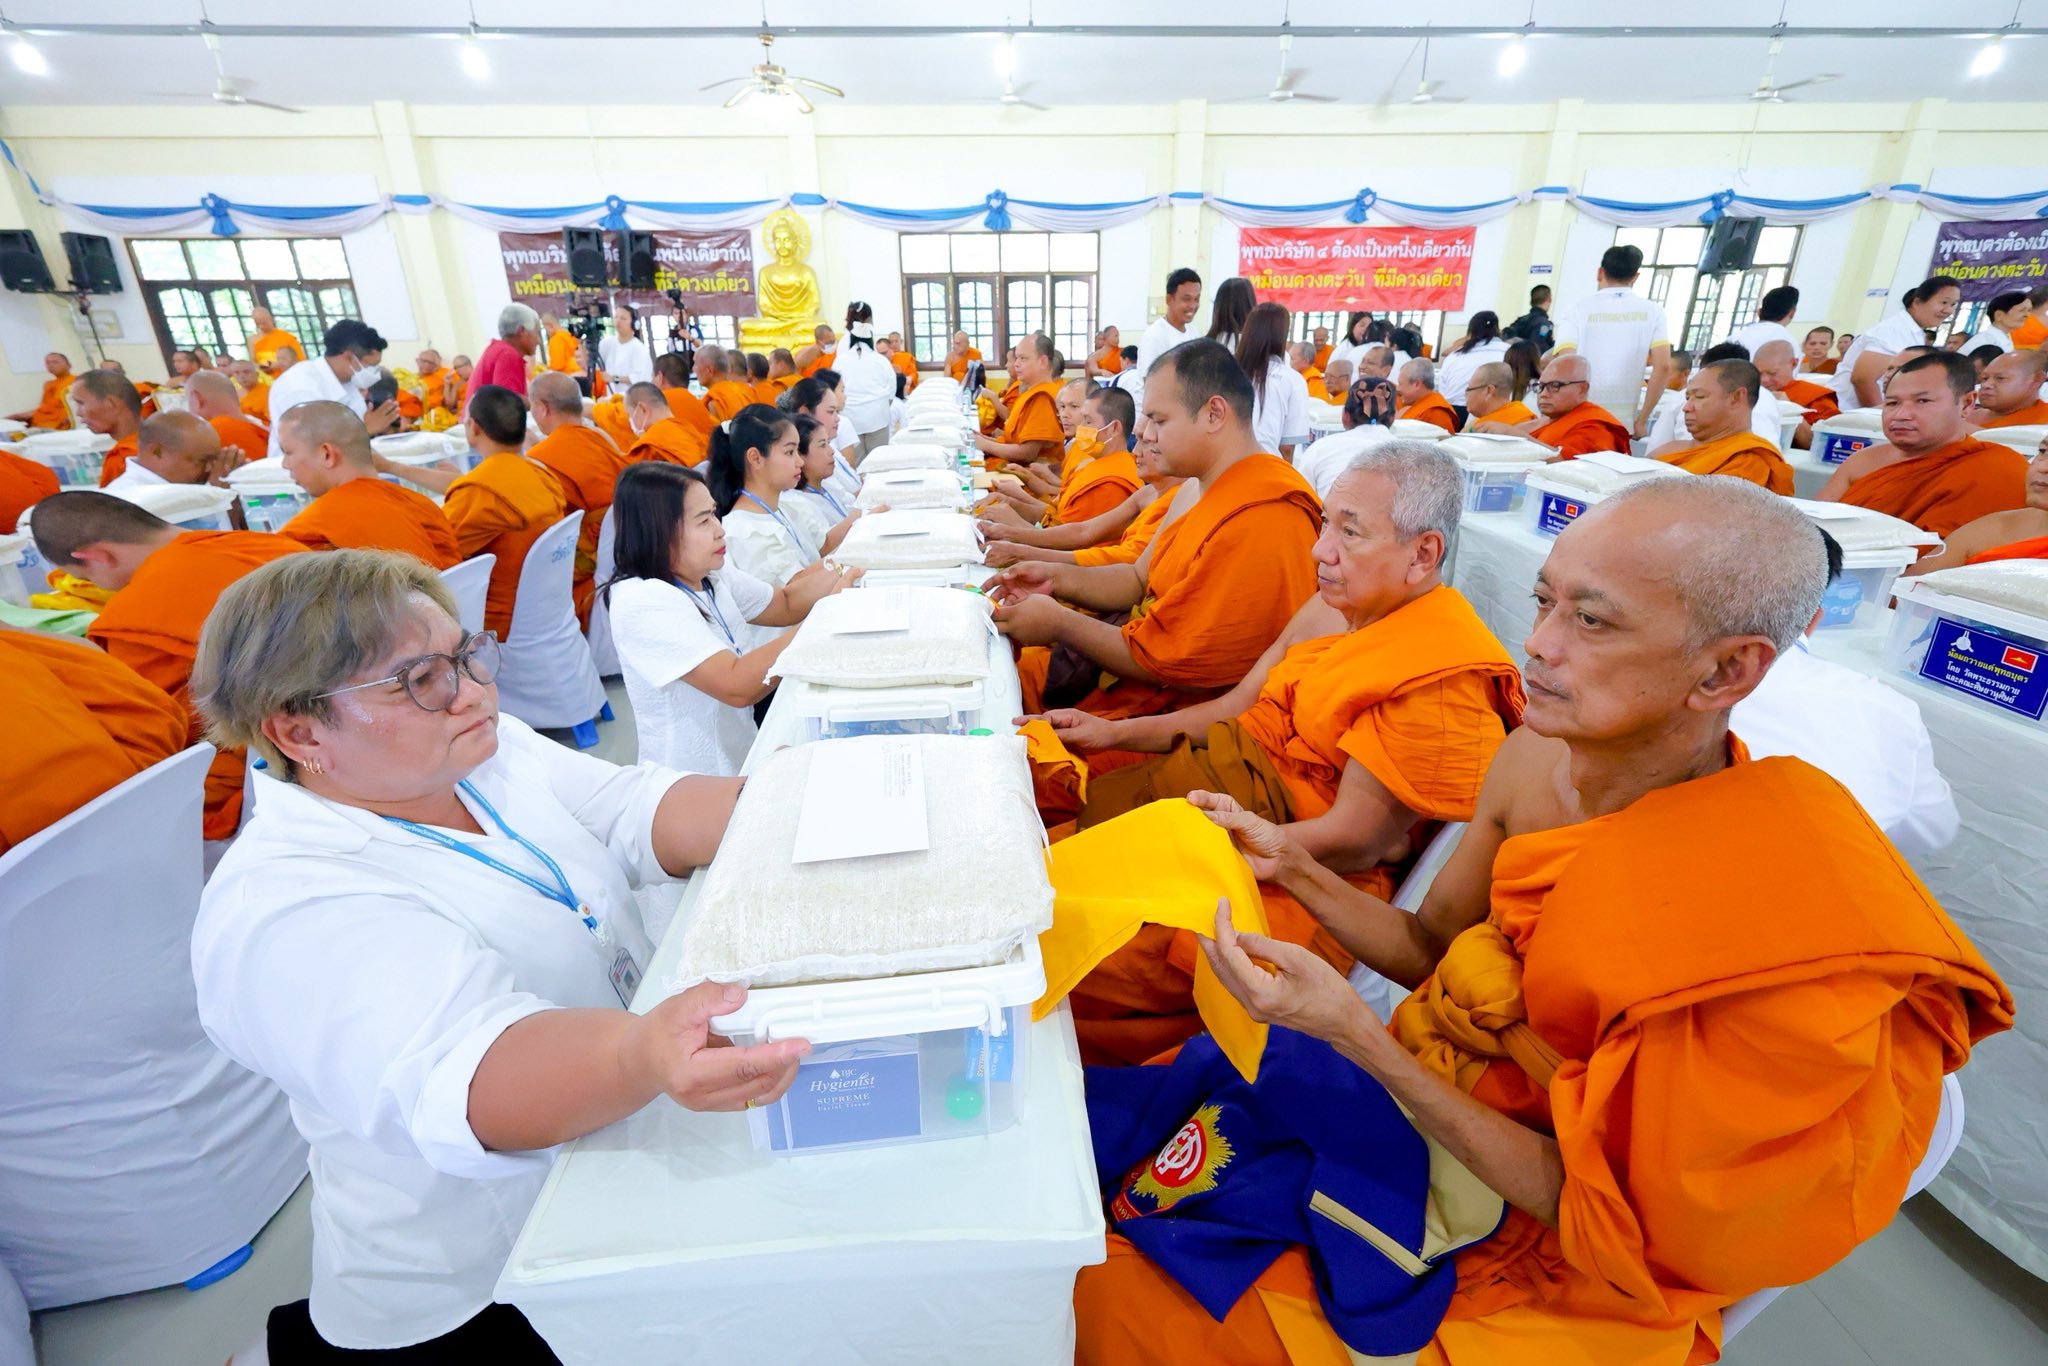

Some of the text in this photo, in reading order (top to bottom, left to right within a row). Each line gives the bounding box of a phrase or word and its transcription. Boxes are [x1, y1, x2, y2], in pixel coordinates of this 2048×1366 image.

[1242, 240, 1315, 266] พุทธบริษัท
[1332, 236, 1473, 258] ต้องเป็นหนึ่งเดียวกัน
[1249, 264, 1463, 289] หมือนดวงตะวัน ที่มีดวงเดียว
[1946, 673, 2016, 703] และคณะศิษยานุศิษย์
[1947, 660, 2020, 695] โดย วัดพระธรรมกาย
[809, 1073, 876, 1093] Hygienist
[817, 1092, 871, 1105] SUPREME
